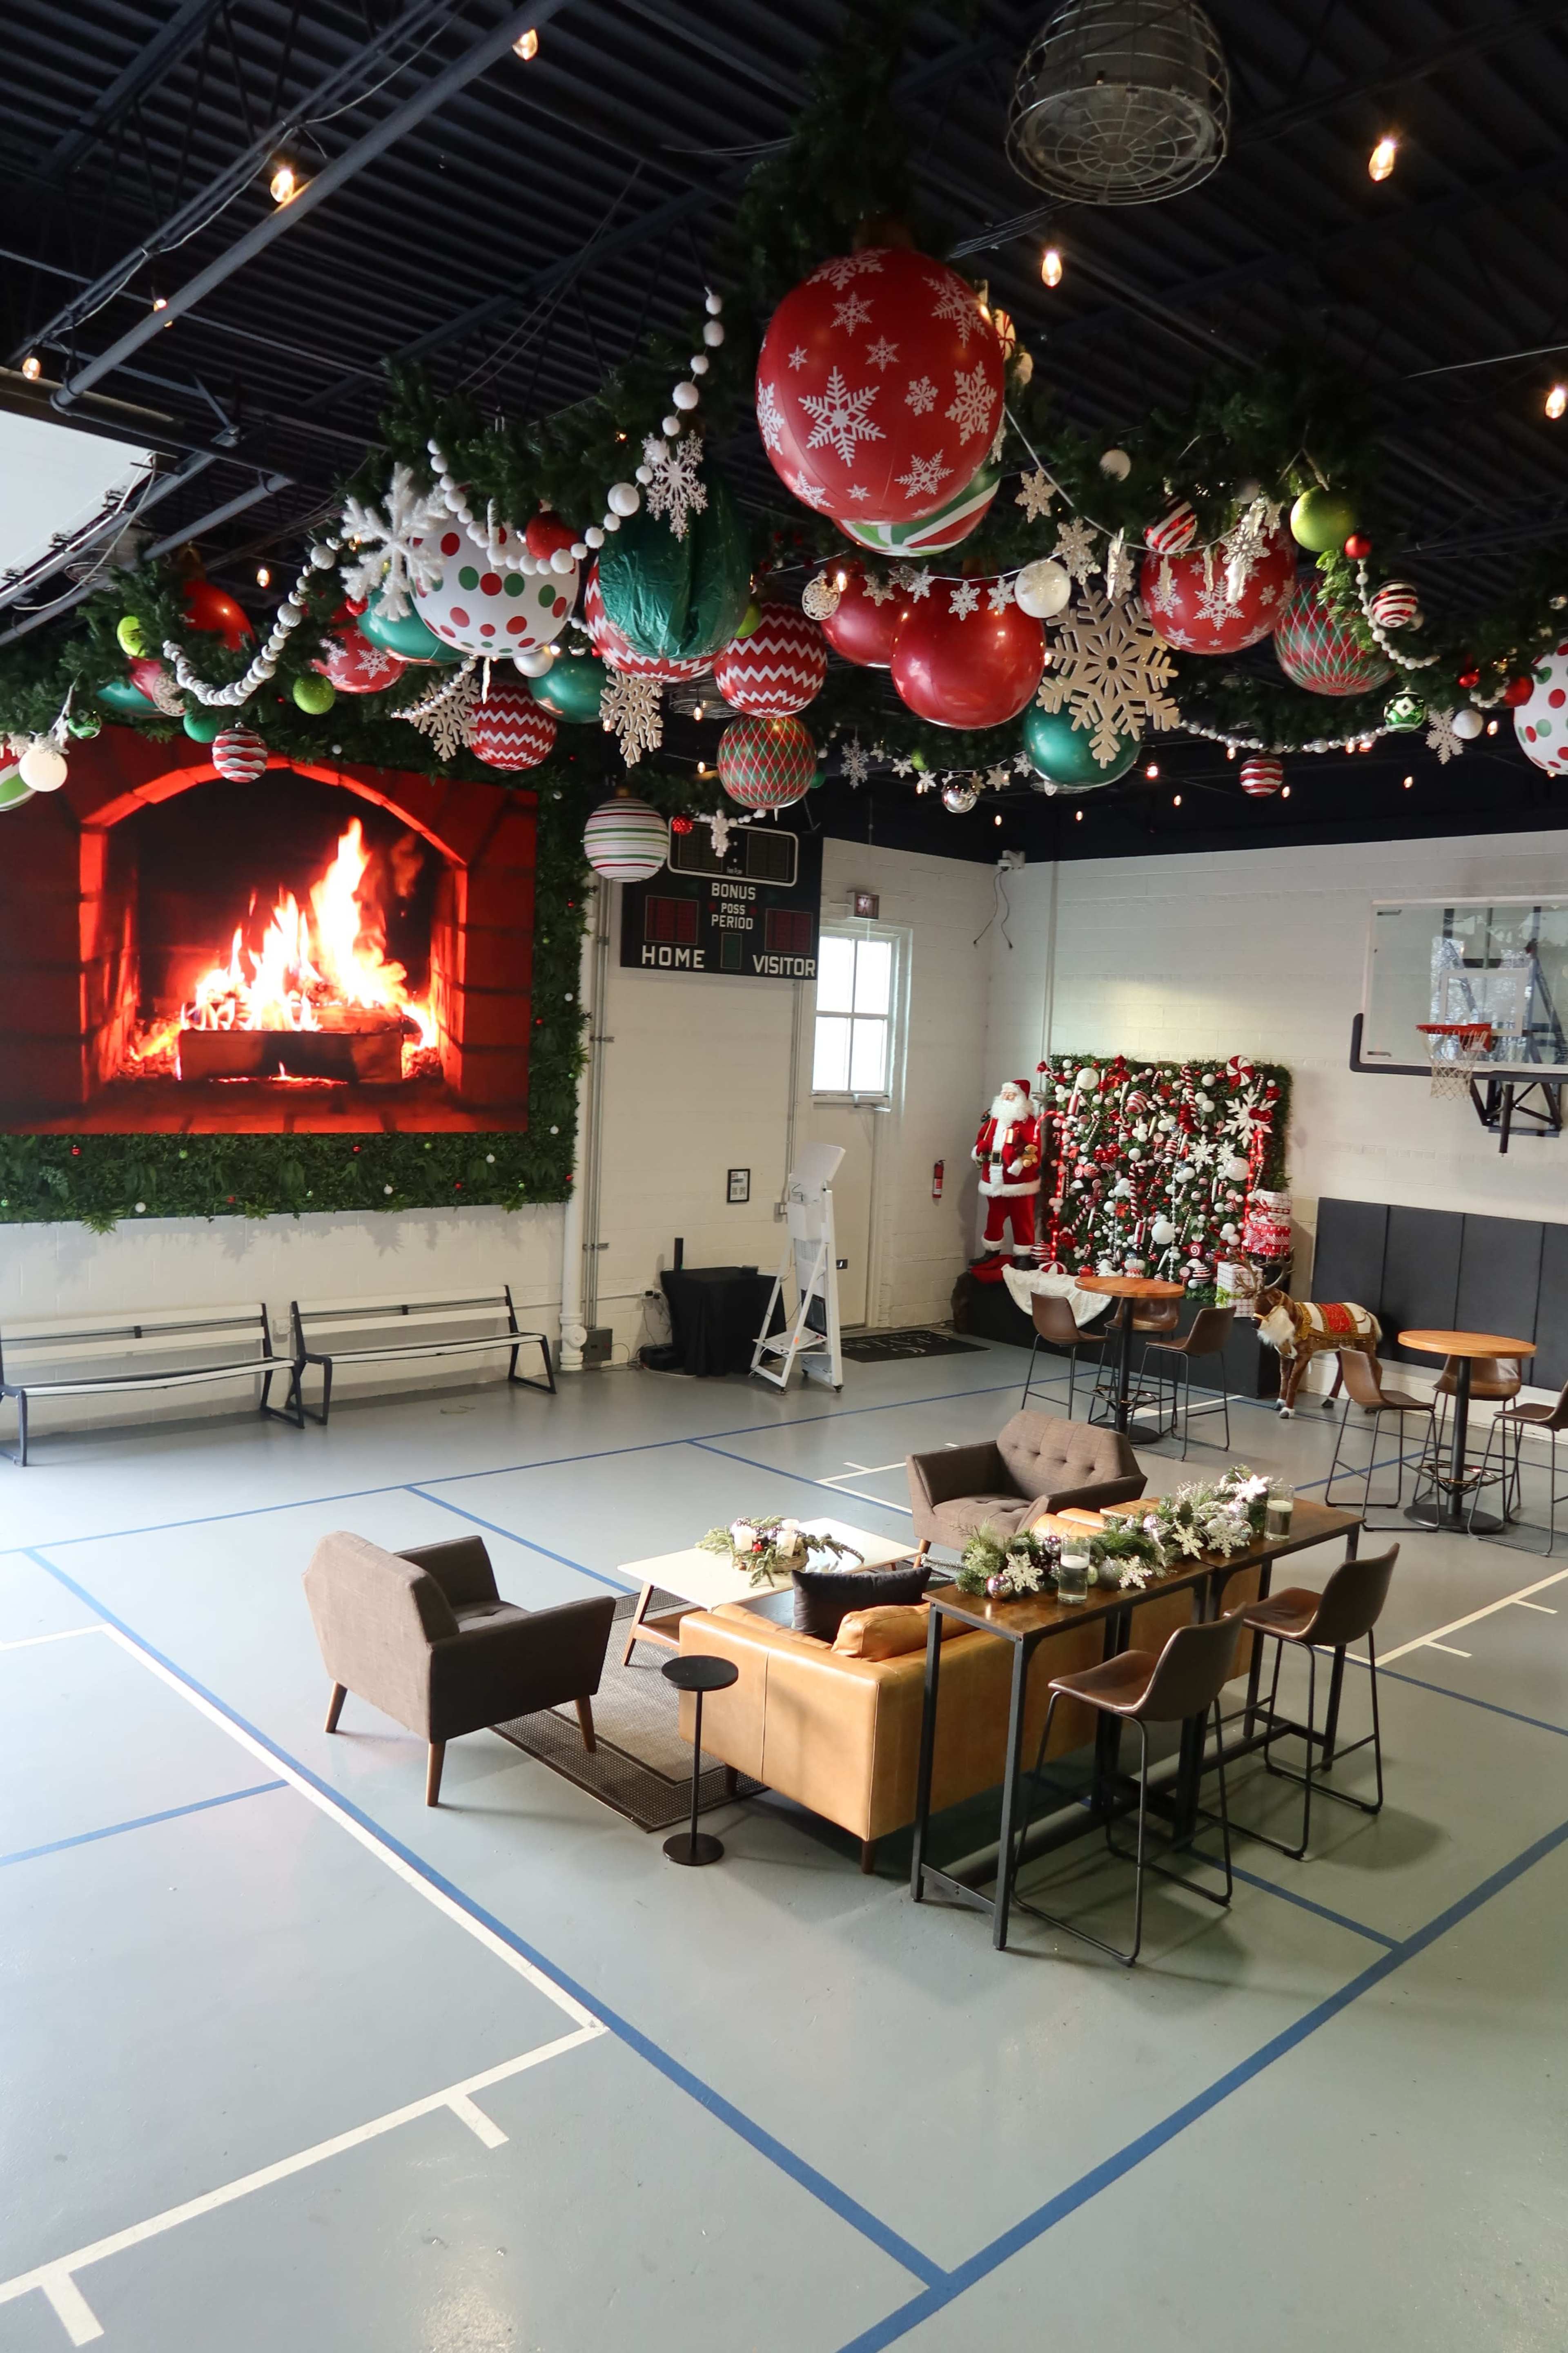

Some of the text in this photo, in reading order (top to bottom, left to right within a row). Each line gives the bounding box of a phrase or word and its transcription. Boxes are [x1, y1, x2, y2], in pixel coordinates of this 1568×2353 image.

[711, 883, 756, 900] BONUS
[721, 903, 746, 915] POSS
[711, 914, 753, 930] PERIOD
[641, 945, 705, 968] HOME
[752, 955, 816, 977] VISITOR
